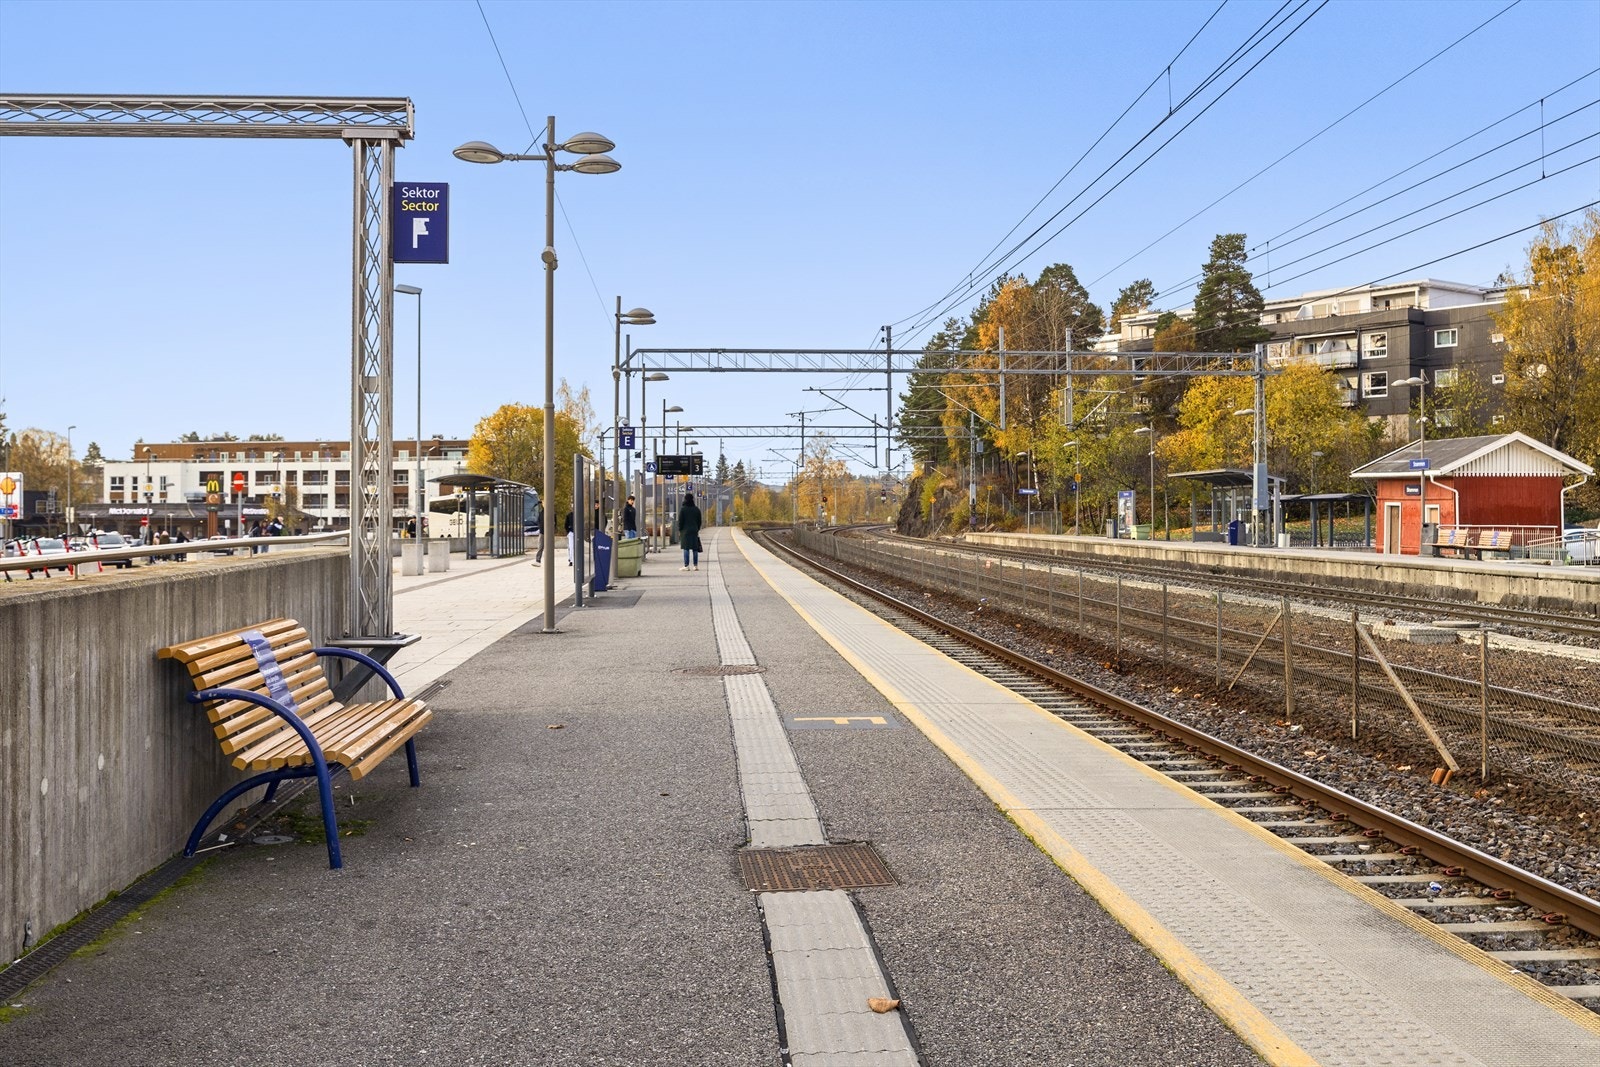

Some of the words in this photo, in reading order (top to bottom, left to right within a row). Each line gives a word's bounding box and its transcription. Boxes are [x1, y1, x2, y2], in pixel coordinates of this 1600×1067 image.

[401, 186, 440, 198] Sektor
[401, 199, 440, 212] Sector
[412, 217, 430, 248] F
[624, 436, 631, 446] E
[694, 464, 700, 472] 3
[108, 507, 154, 515] McDonalds
[793, 715, 888, 725] F
